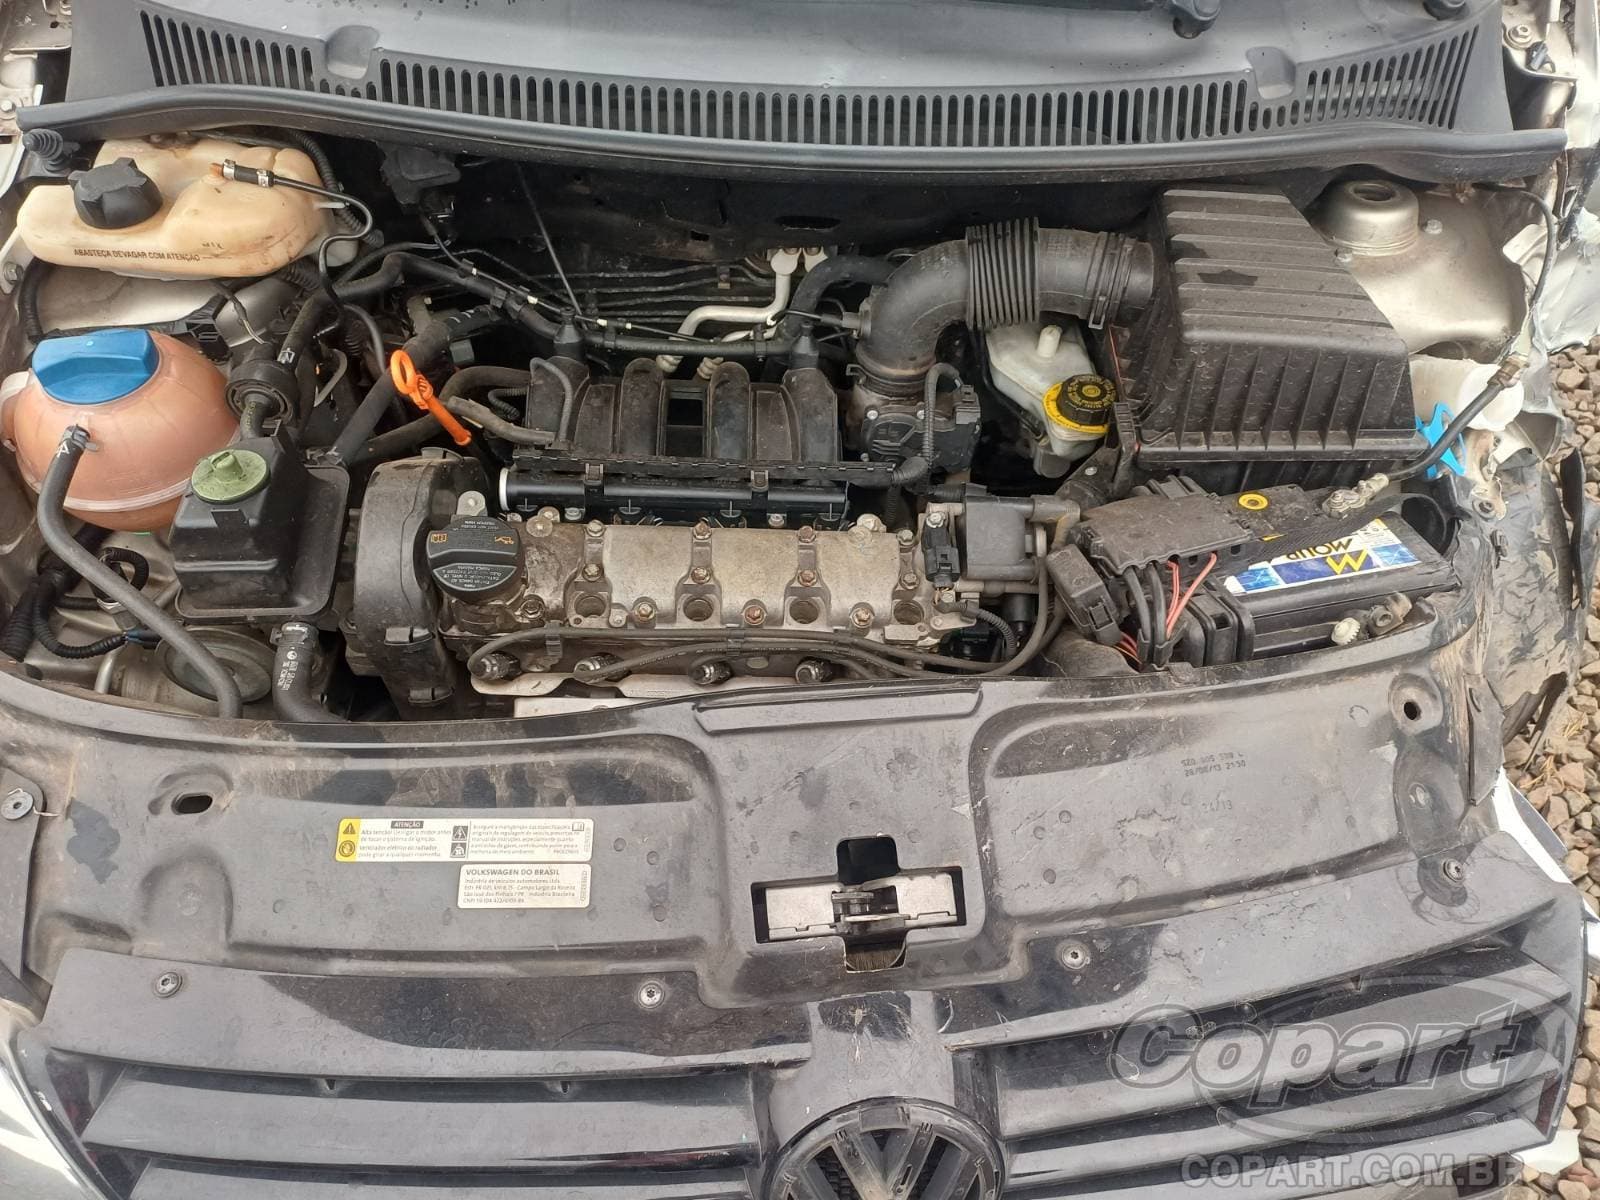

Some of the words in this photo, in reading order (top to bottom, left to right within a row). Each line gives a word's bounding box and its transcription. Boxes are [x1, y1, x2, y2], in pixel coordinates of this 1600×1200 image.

[74, 249, 112, 258] ABASTEÇA
[113, 250, 147, 259] DEVAGAR
[148, 252, 165, 260] COM
[166, 252, 200, 261] ATENÇÃO
[393, 820, 422, 829] ATENÇÃO
